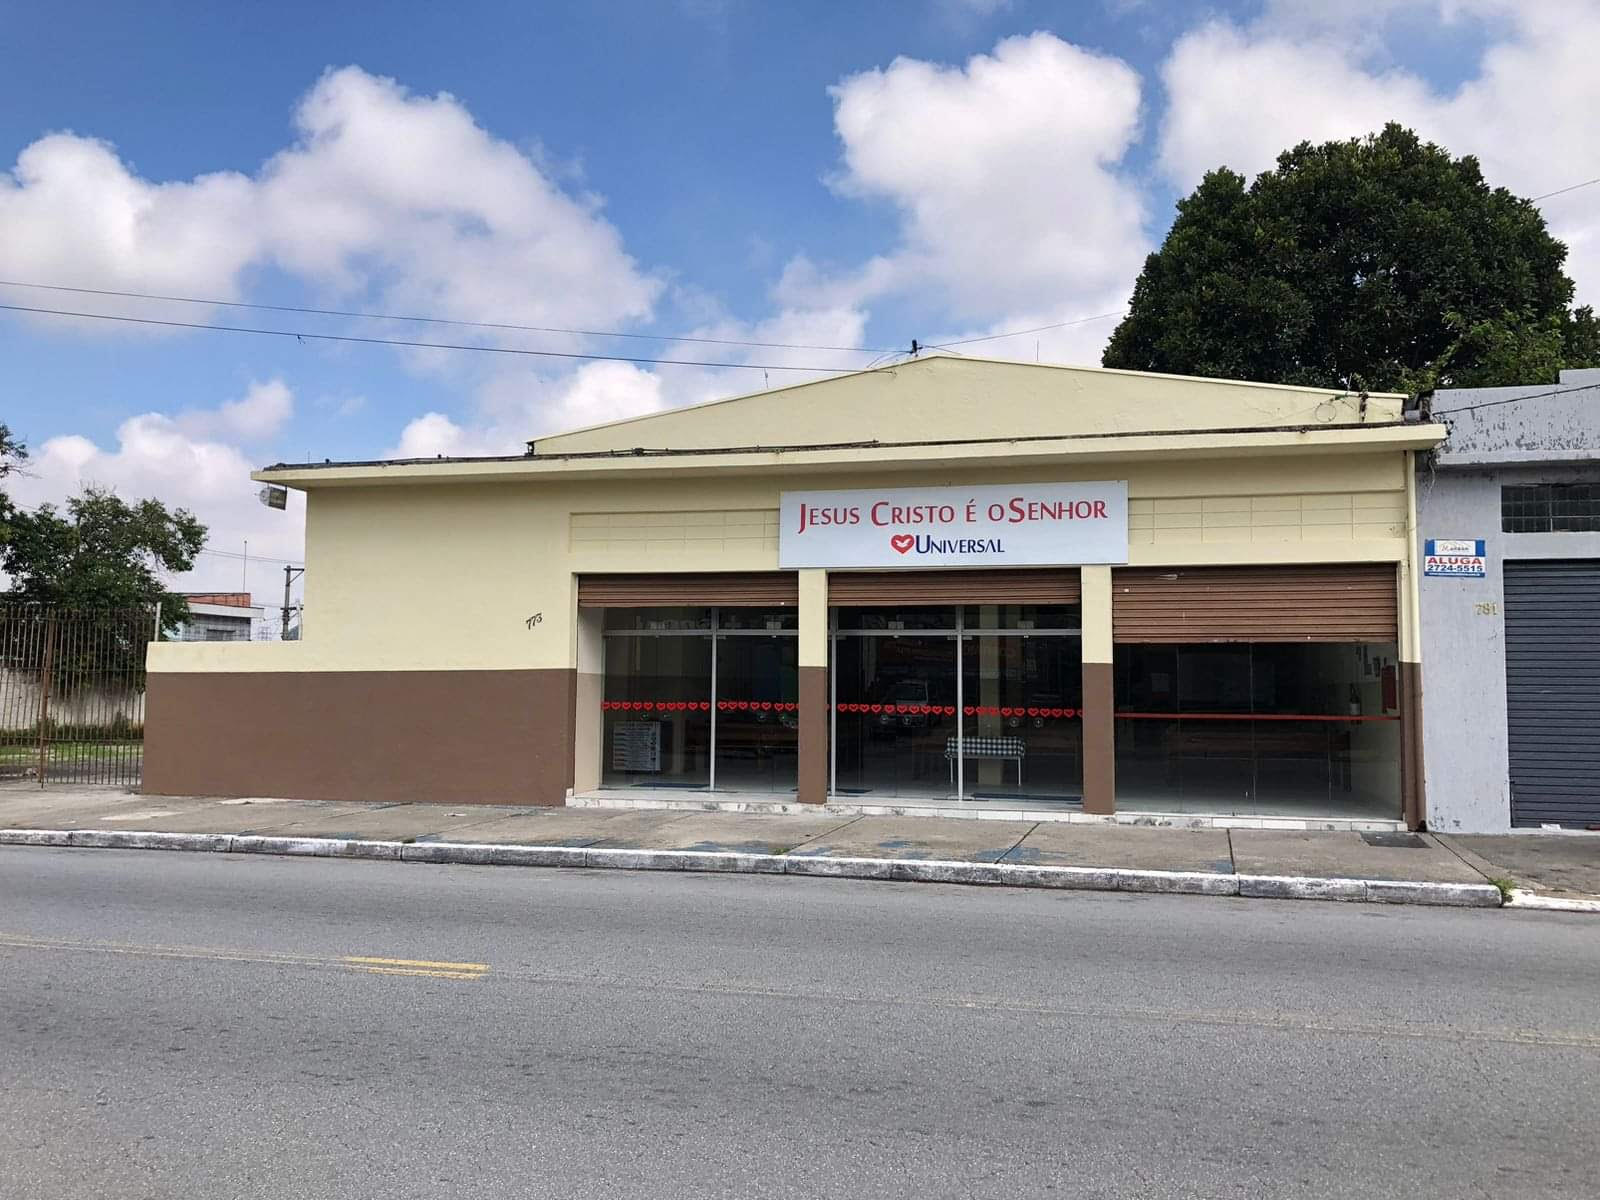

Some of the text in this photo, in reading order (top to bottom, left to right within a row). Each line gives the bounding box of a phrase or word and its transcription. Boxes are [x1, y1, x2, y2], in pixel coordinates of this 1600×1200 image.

[798, 503, 860, 534] JESUS
[871, 501, 955, 526] CRISTO
[966, 499, 976, 522] É
[915, 534, 1005, 555] UNIVERSAL
[1427, 557, 1482, 565] ALUGA
[1427, 564, 1483, 572] 2724-5515
[526, 612, 543, 631] 773
